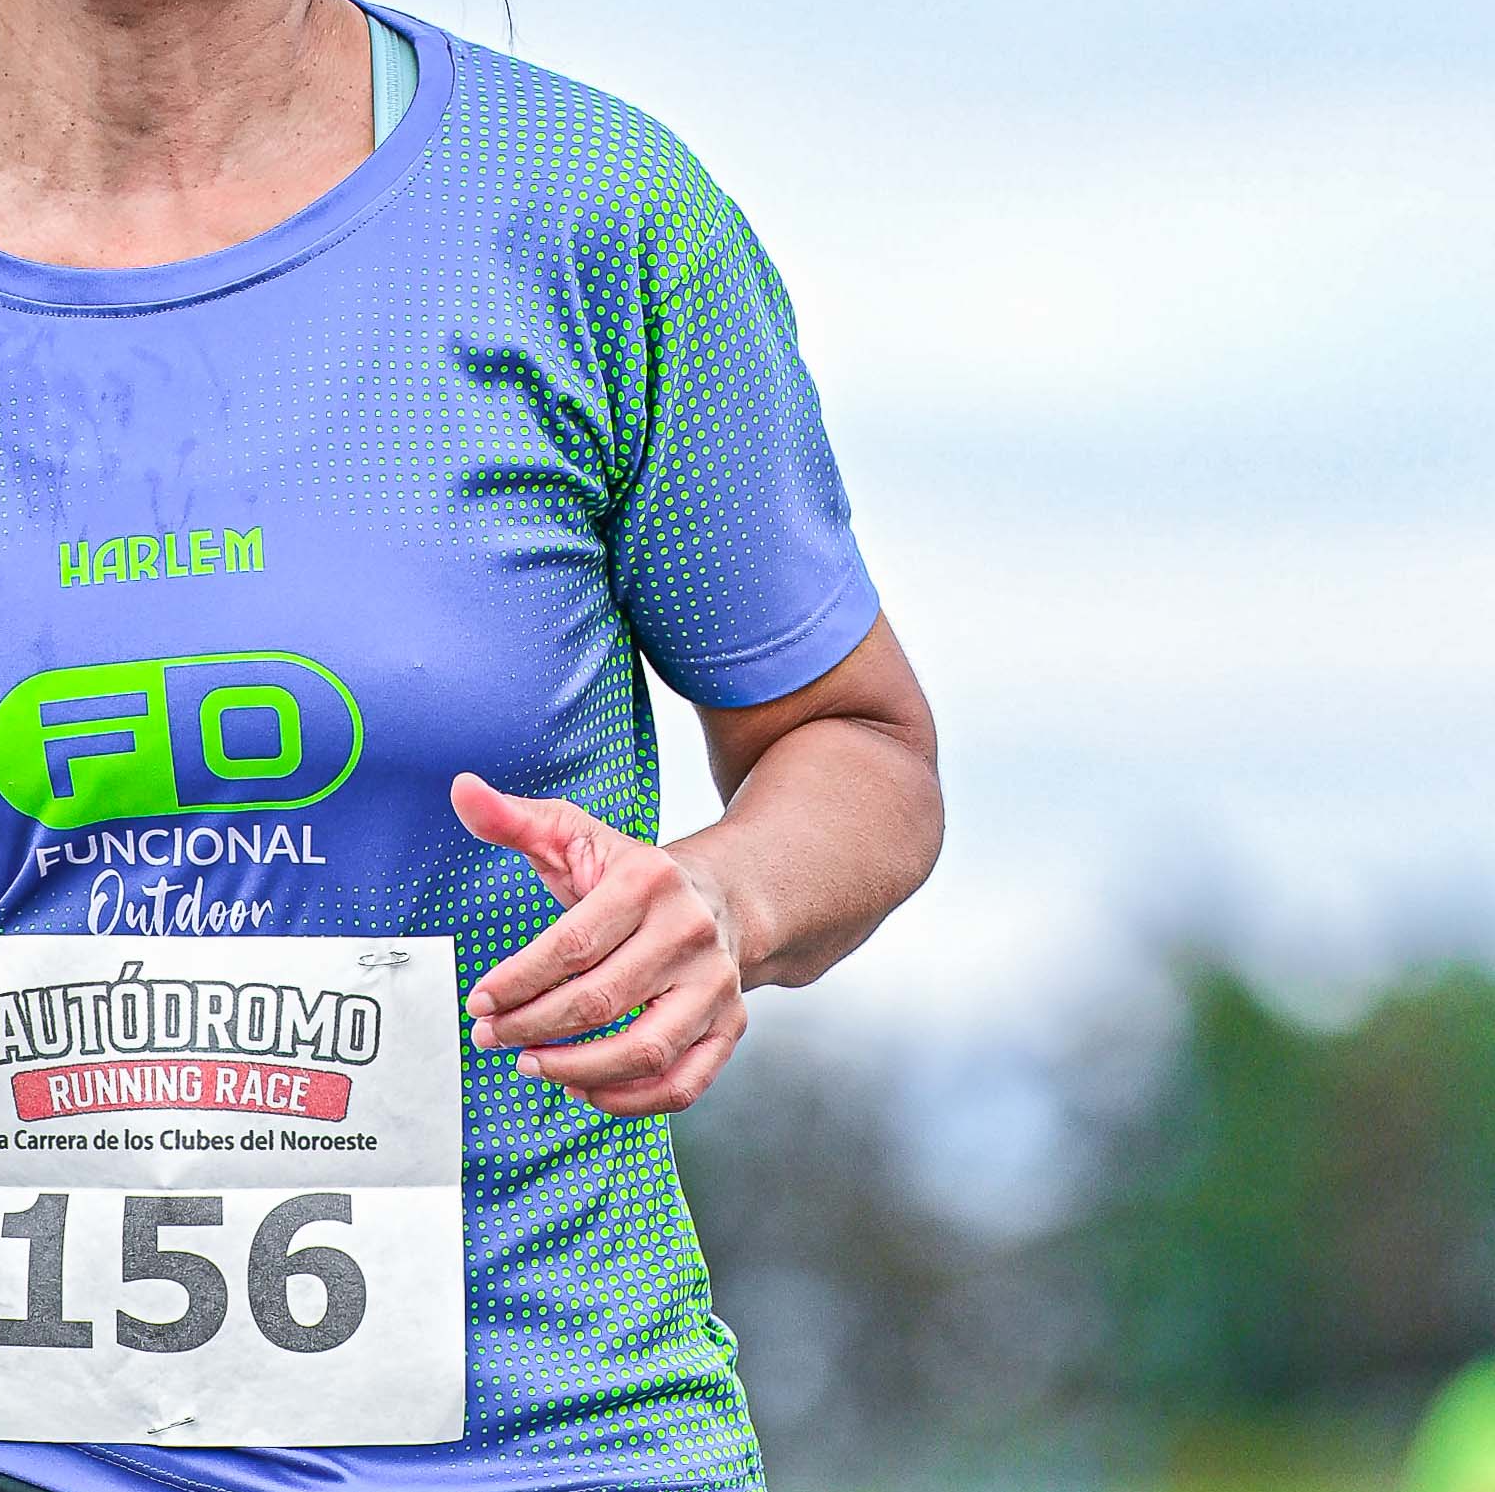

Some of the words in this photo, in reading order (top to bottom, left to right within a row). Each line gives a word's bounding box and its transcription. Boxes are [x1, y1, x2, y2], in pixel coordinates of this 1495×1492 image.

[58, 526, 265, 587] HARLEM
[35, 825, 327, 877] FUNCIONAL
[88, 868, 274, 936] Outdoor
[49, 1068, 203, 1111] RUNNING
[214, 1066, 312, 1111] RACE
[14, 1131, 88, 1150] Carrera
[93, 1131, 120, 1151] de
[124, 1129, 154, 1151] los
[160, 1128, 235, 1151] Clubes
[240, 1129, 275, 1151] del
[281, 1132, 378, 1151] Noroeste
